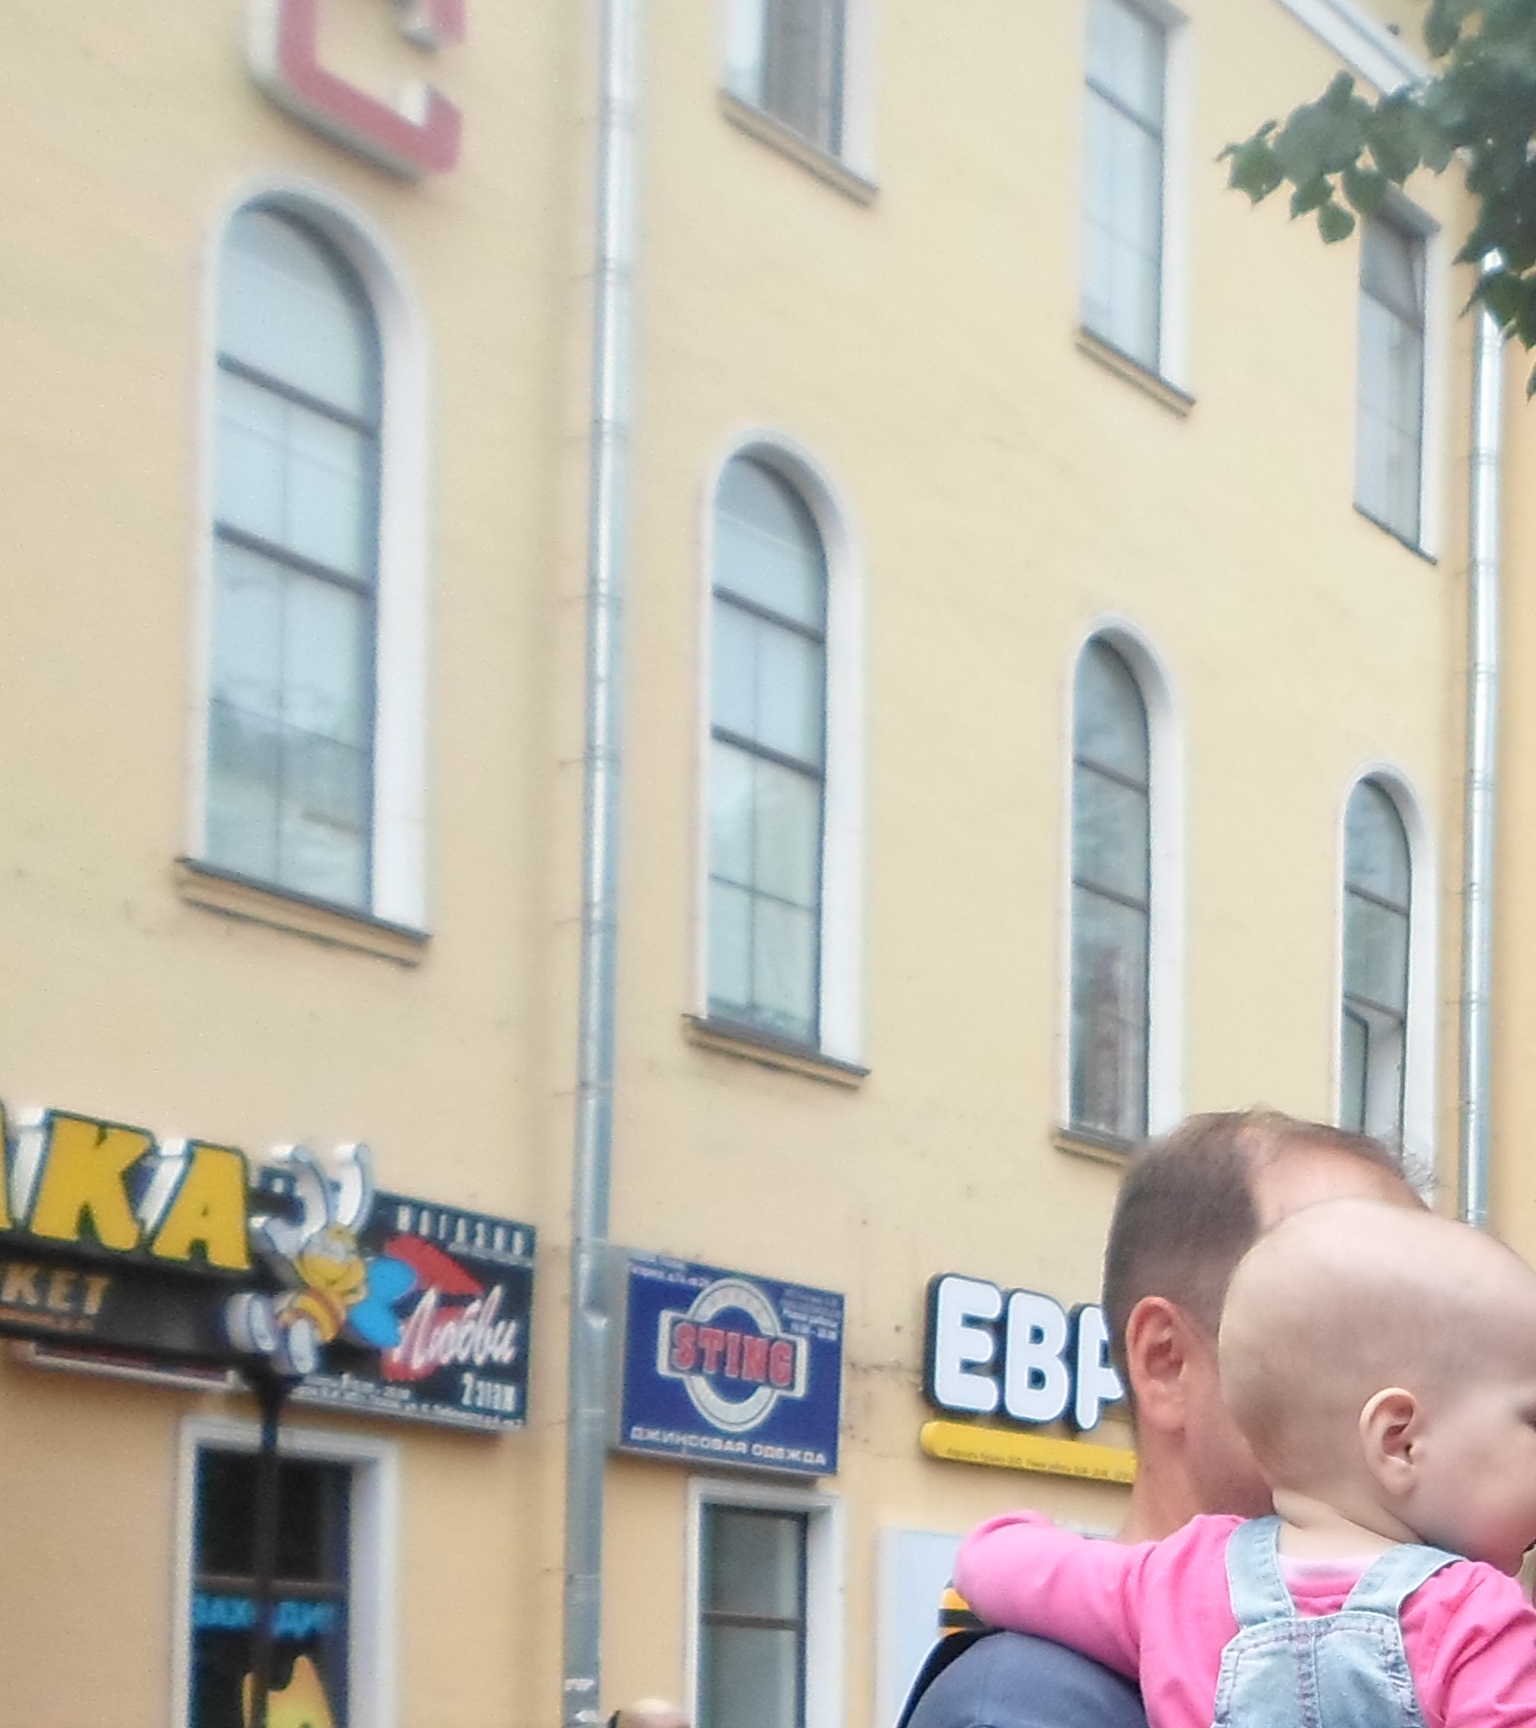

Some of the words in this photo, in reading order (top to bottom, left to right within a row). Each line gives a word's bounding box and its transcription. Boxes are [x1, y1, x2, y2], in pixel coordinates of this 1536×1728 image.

[0, 1100, 253, 1272] КА
[673, 1321, 794, 1387] STING
[630, 1426, 747, 1454] ДЖИНСОВАЯ
[751, 1443, 827, 1466] ОДЕЖДА
